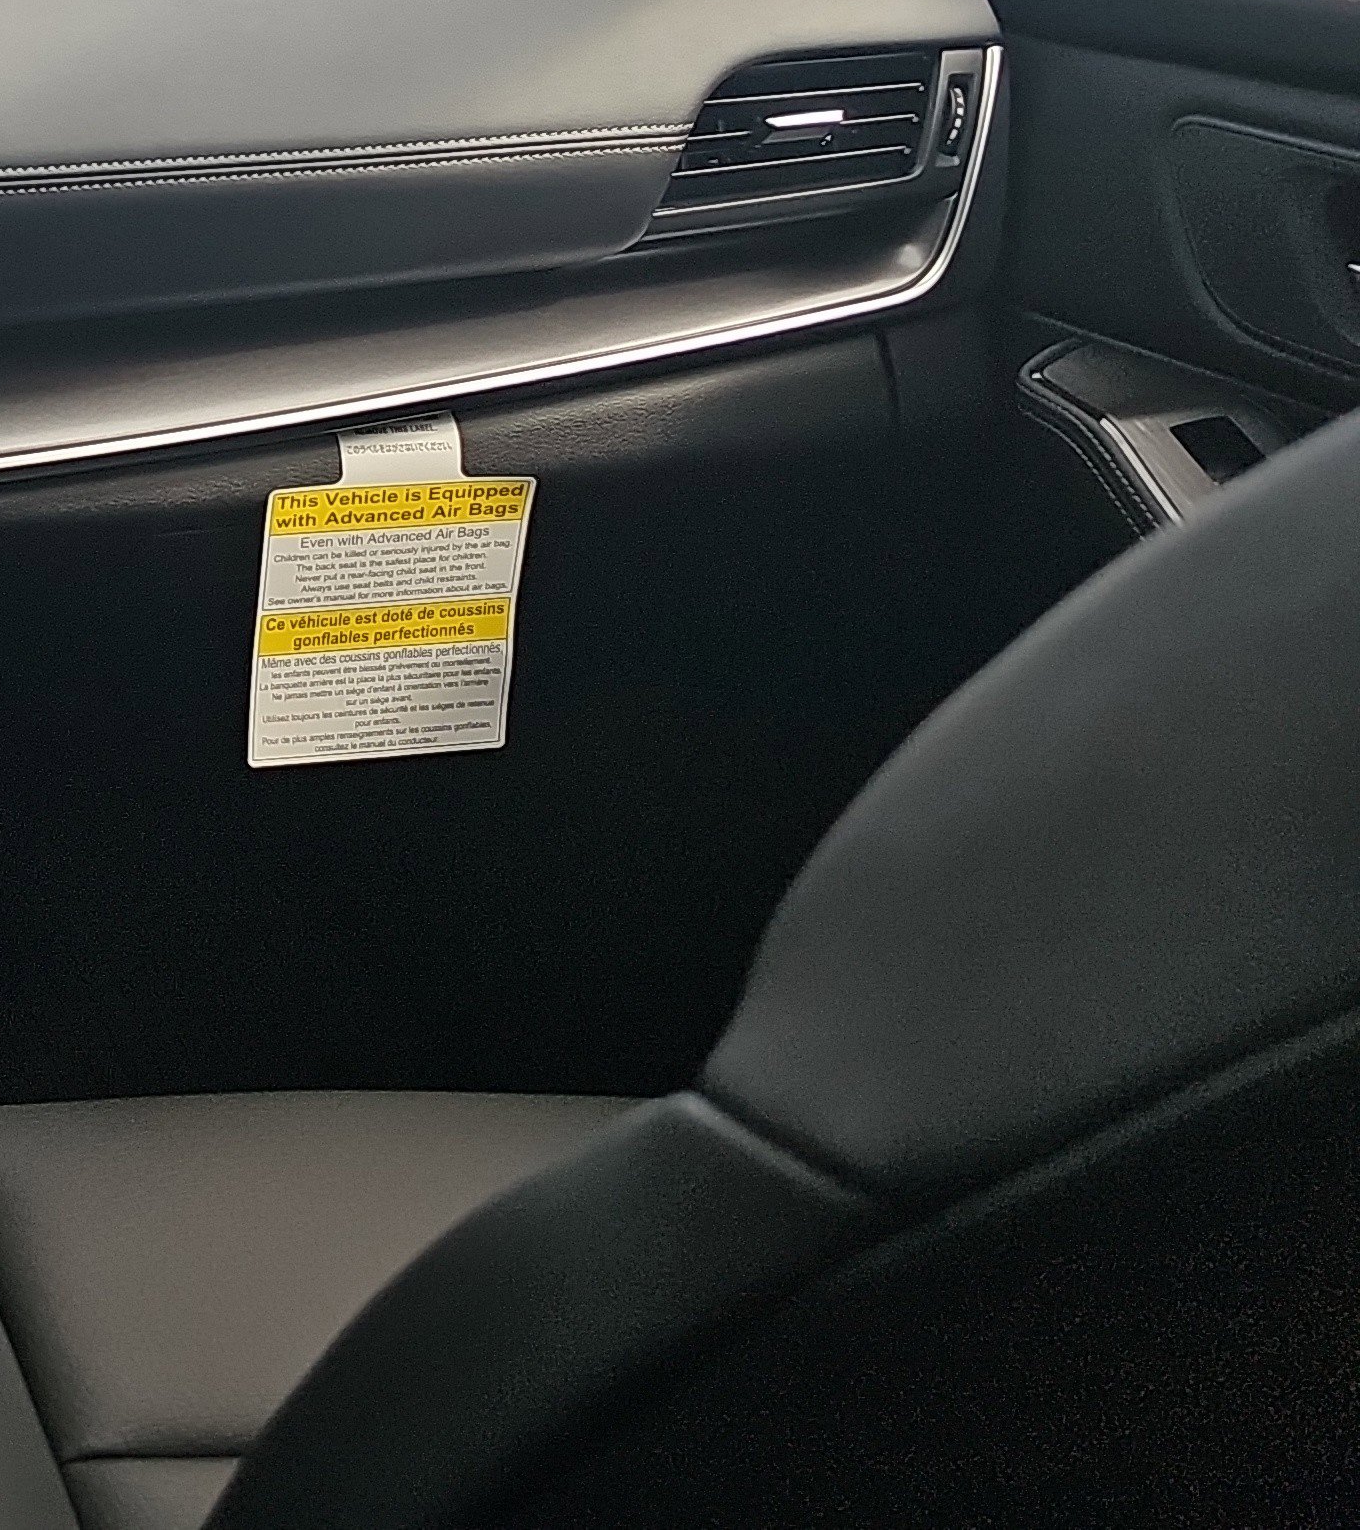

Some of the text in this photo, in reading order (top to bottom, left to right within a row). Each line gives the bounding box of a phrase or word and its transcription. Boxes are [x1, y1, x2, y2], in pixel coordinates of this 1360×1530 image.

[277, 484, 524, 510] This Vehicle is Equipped
[275, 502, 519, 528] with Advanced Air Bags
[300, 526, 490, 549] Even with Advanced Air Bags
[273, 553, 311, 563] Children
[331, 551, 342, 559] be
[344, 549, 367, 558] killed
[380, 545, 419, 556] seriously
[420, 542, 450, 554] injured
[452, 542, 463, 552] by
[464, 541, 479, 550] the
[480, 540, 493, 549] air
[296, 563, 313, 572] The
[315, 561, 336, 570] back
[338, 561, 357, 569] seat
[360, 560, 367, 568] is
[369, 559, 383, 567] the
[385, 556, 411, 566] safest
[413, 555, 436, 566] place
[438, 553, 450, 562] for
[295, 574, 321, 583] Never
[323, 572, 338, 582] put
[396, 566, 416, 576] child
[418, 565, 437, 574] seat
[439, 564, 447, 572] in
[449, 563, 463, 572] the
[300, 584, 332, 594] Always
[333, 582, 351, 591] use
[352, 581, 371, 590] seat
[373, 579, 394, 588] belts
[395, 577, 413, 586] and
[414, 575, 435, 585] child
[267, 597, 286, 606] See
[323, 592, 356, 602] manual
[357, 591, 370, 599] for
[371, 590, 394, 599] more
[395, 586, 444, 597] information
[445, 583, 470, 593] about
[471, 582, 483, 591] air
[265, 602, 505, 631] Ce véhicule est doté de coussins
[293, 622, 475, 650] gonflables perfectionnés
[261, 657, 292, 669] Même
[293, 657, 317, 667] avec
[318, 654, 337, 665] des
[339, 651, 381, 663] coussins
[383, 645, 433, 663] gonflables
